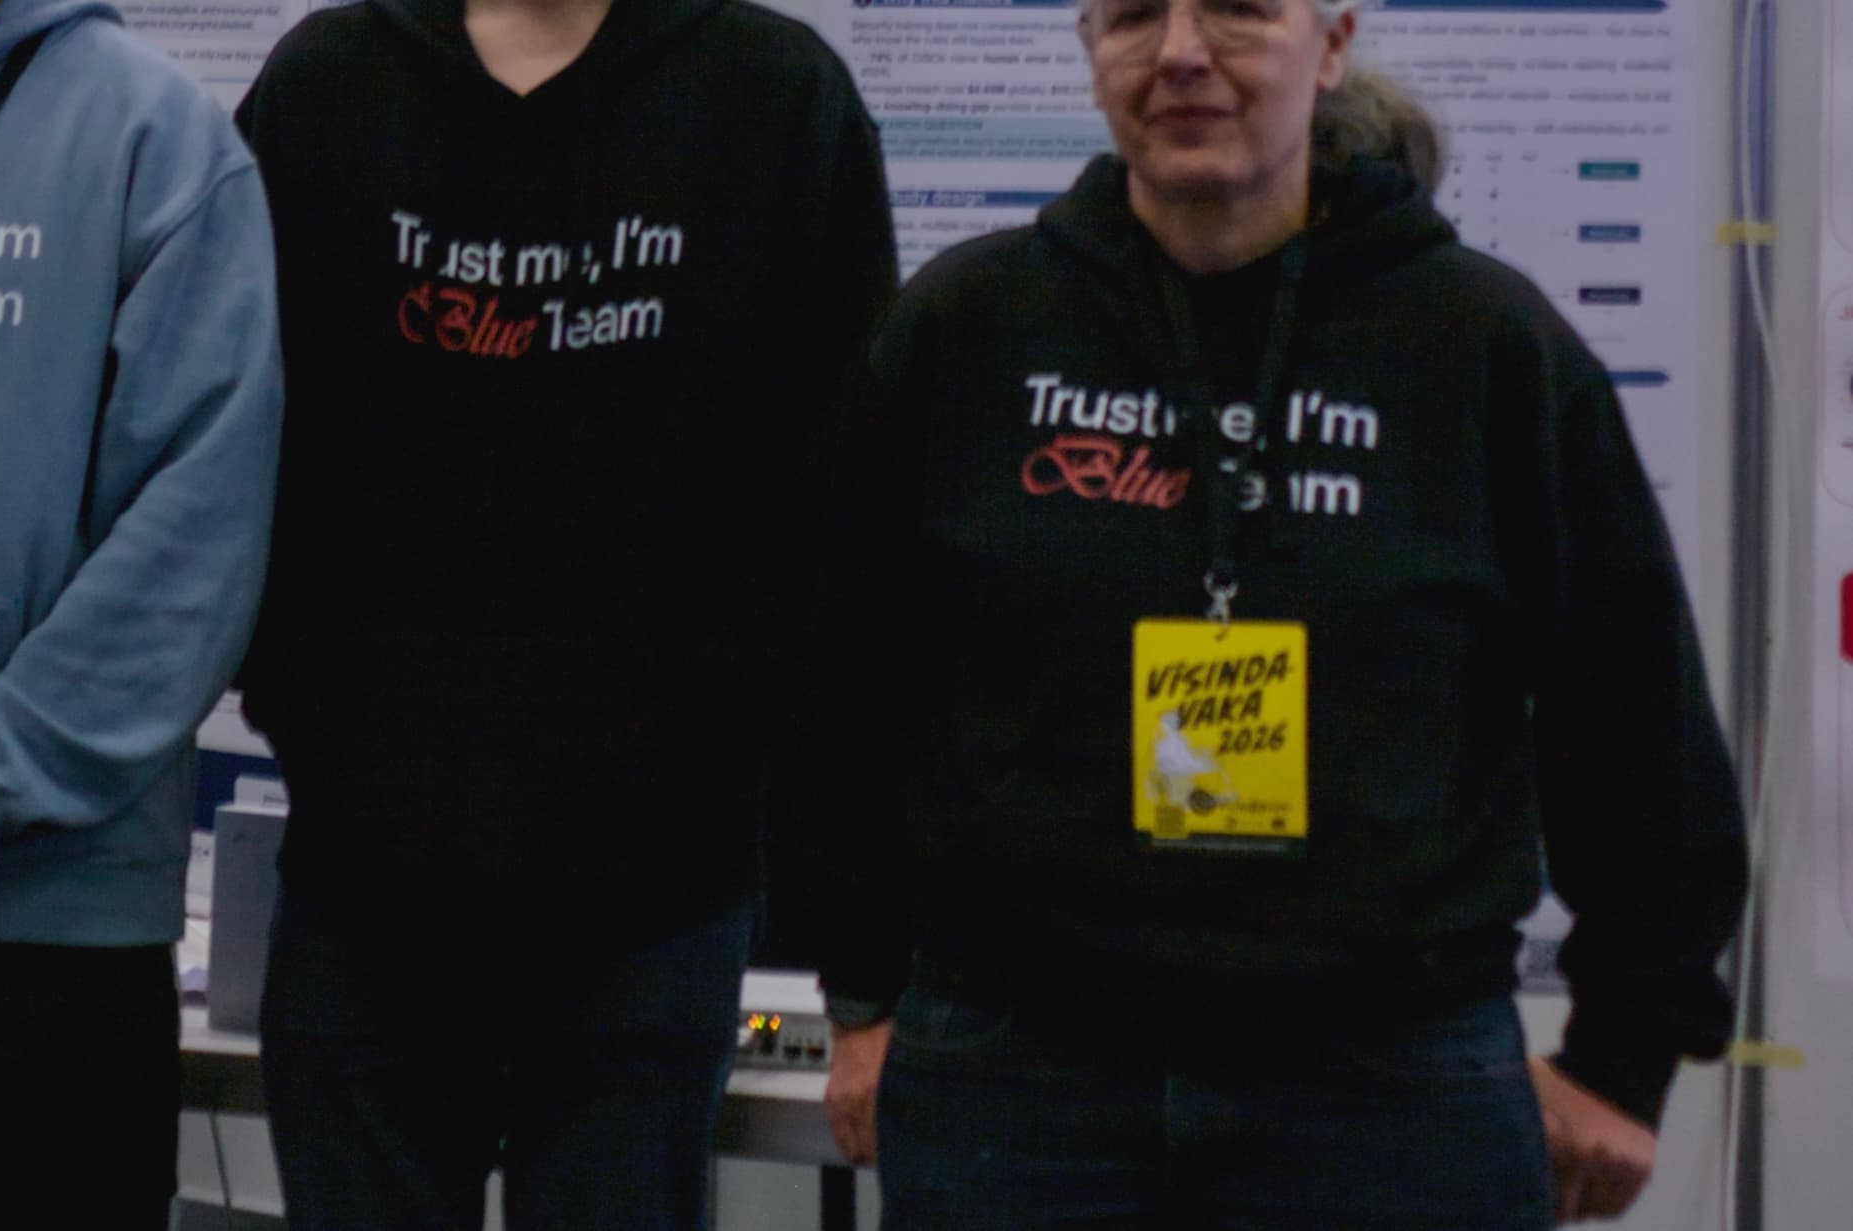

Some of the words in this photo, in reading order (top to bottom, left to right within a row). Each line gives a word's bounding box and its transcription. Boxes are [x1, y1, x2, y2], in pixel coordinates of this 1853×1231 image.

[891, 191, 927, 208] tudy
[612, 215, 683, 270] I'm
[1024, 373, 1159, 438] Trust
[1285, 390, 1379, 450] I'm
[1021, 432, 1193, 511] Blue
[1177, 688, 1264, 731] VAKA
[1217, 721, 1288, 757] 2026
